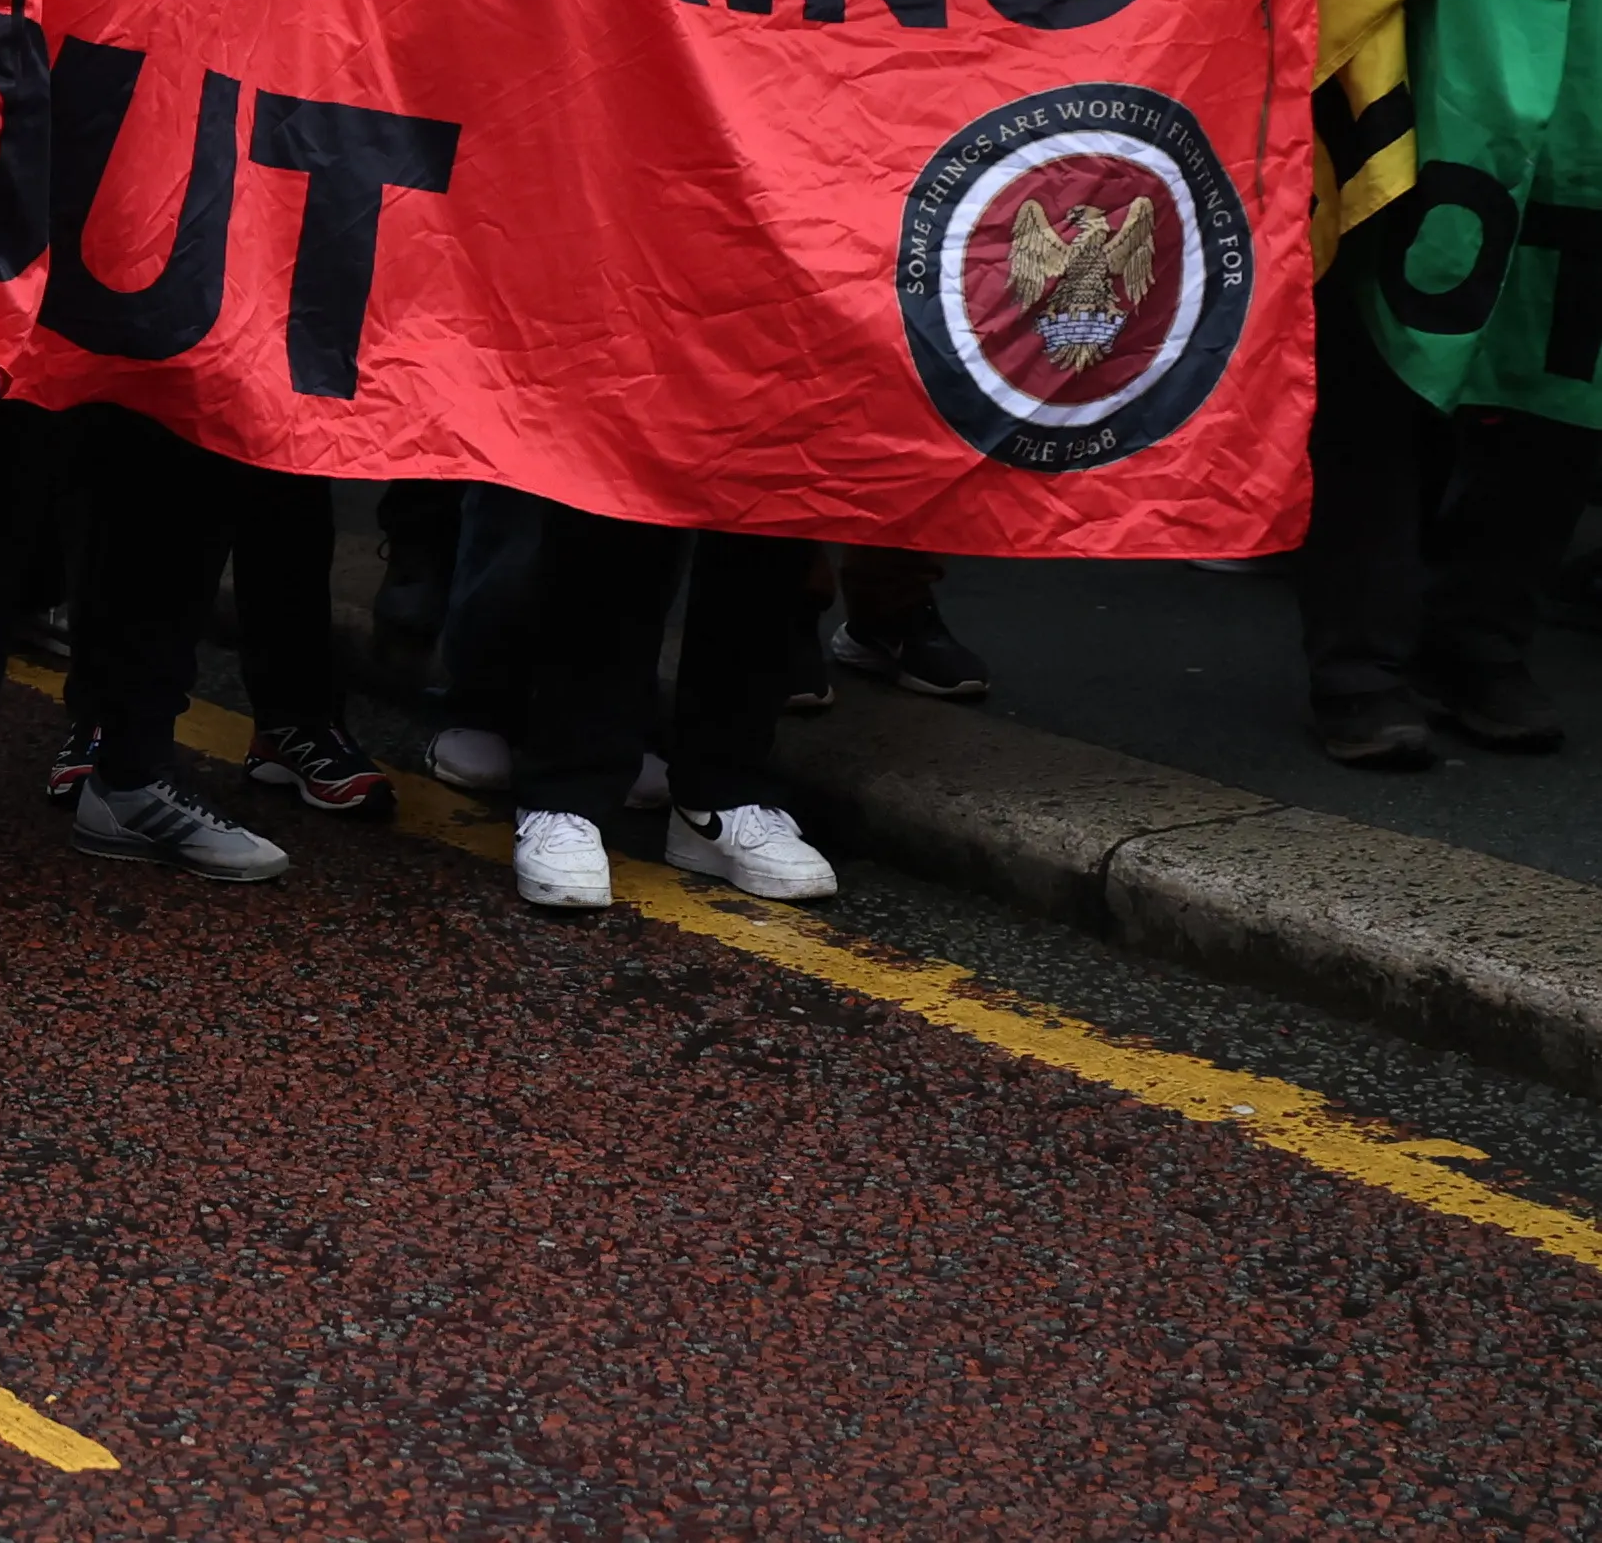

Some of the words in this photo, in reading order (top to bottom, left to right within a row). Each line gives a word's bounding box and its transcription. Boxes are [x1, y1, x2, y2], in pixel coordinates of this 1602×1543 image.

[906, 220, 932, 295] SOME
[919, 133, 994, 217] THINGS
[998, 107, 1050, 143] ARE
[1056, 99, 1161, 131] WORTH
[1167, 121, 1232, 229] FIGHTING
[1218, 233, 1243, 289] FOR
[1012, 434, 1057, 463] THE
